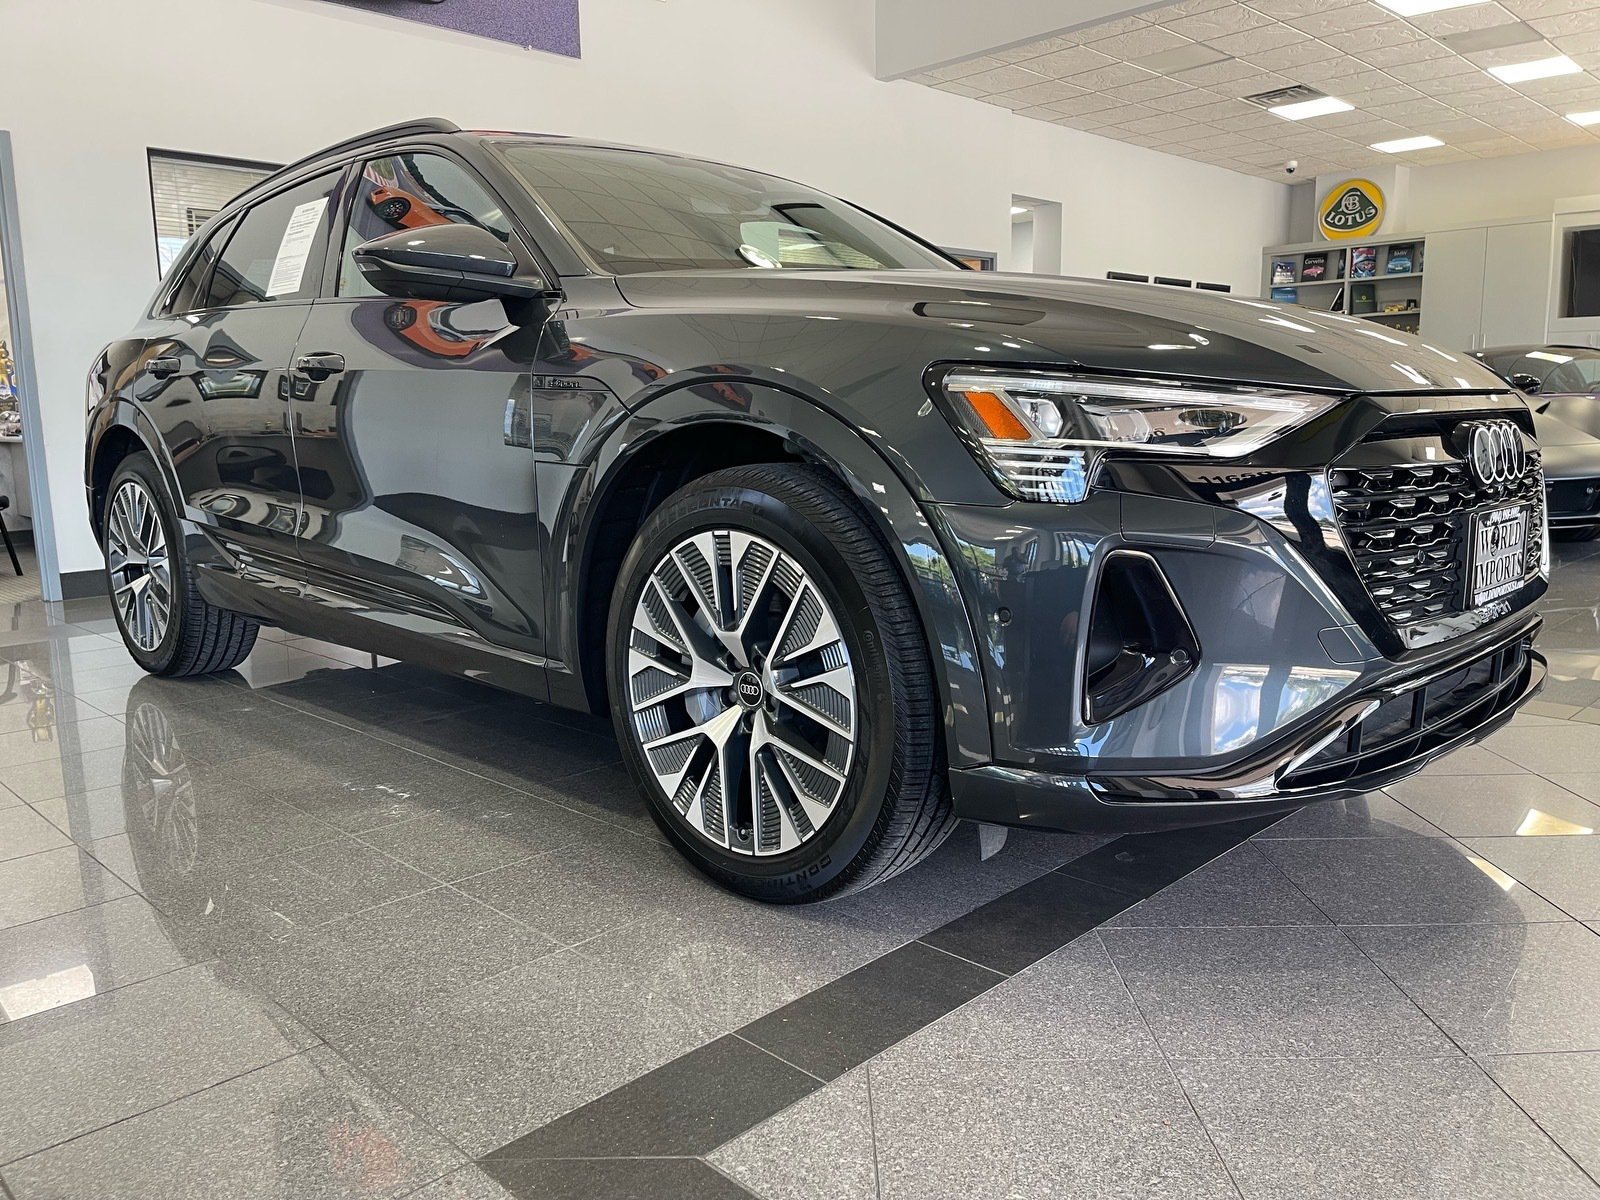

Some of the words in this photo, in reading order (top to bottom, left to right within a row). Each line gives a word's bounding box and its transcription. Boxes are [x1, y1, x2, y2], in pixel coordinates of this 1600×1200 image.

[1326, 205, 1376, 226] LOTUS
[1304, 257, 1325, 266] Corvette
[1480, 521, 1521, 556] WORLD
[1476, 551, 1523, 589] IMPORTS
